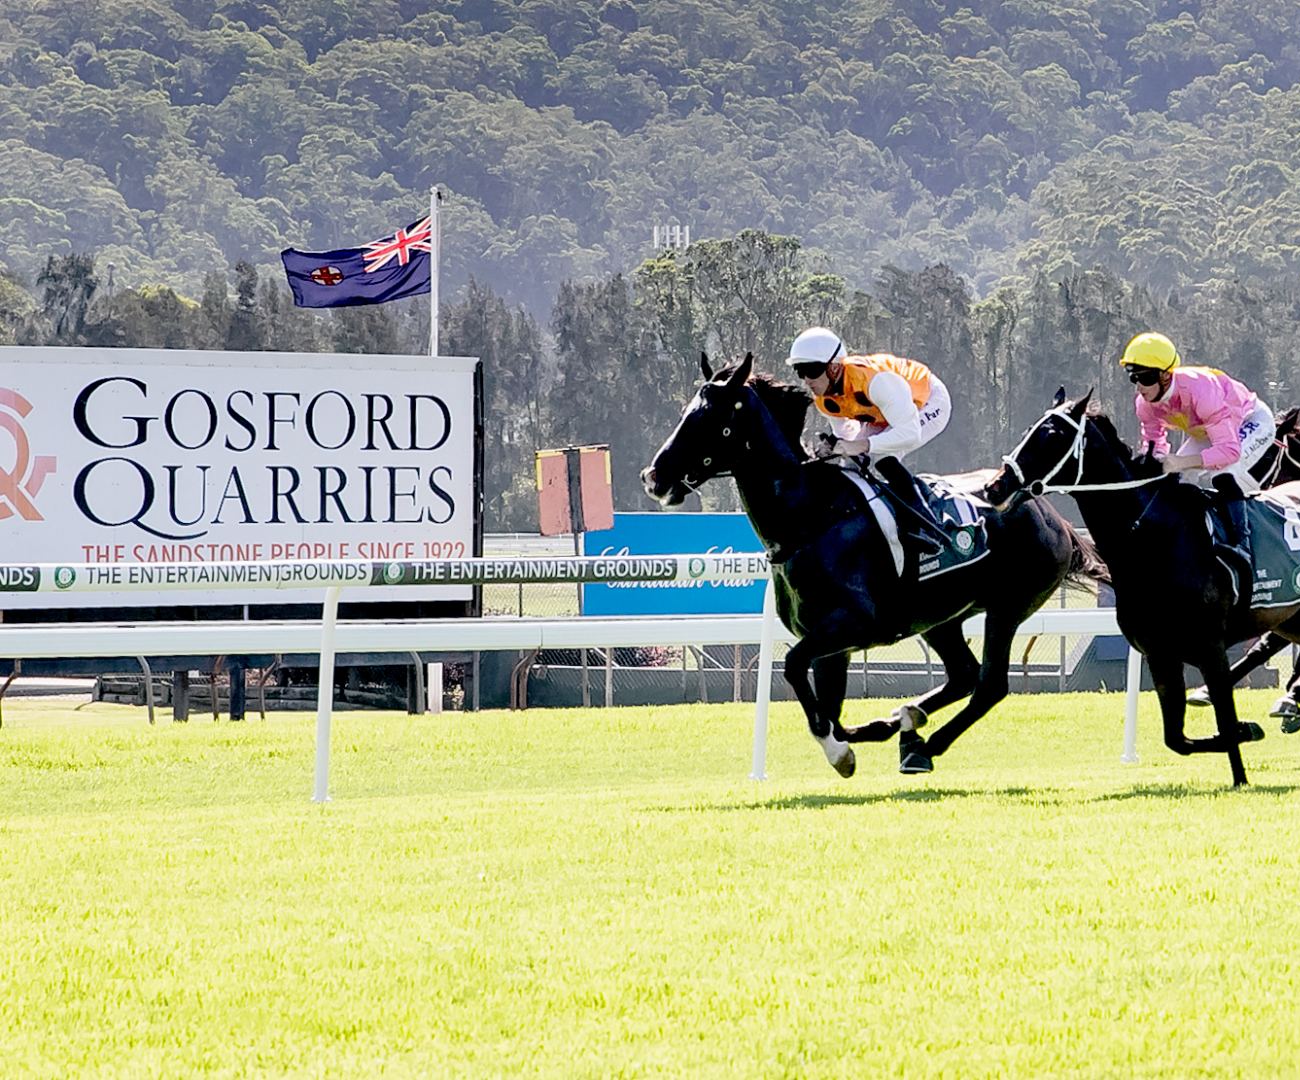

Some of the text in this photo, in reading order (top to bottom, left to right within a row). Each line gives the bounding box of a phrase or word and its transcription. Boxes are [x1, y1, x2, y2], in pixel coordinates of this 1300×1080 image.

[73, 376, 451, 452] GOSFORD
[73, 457, 455, 540] QUARRIES
[86, 566, 121, 584] THE
[412, 562, 445, 580] THE
[450, 560, 590, 580] ENTERTAINMENT
[593, 559, 673, 578] GROUNDS
[714, 558, 741, 573] THE
